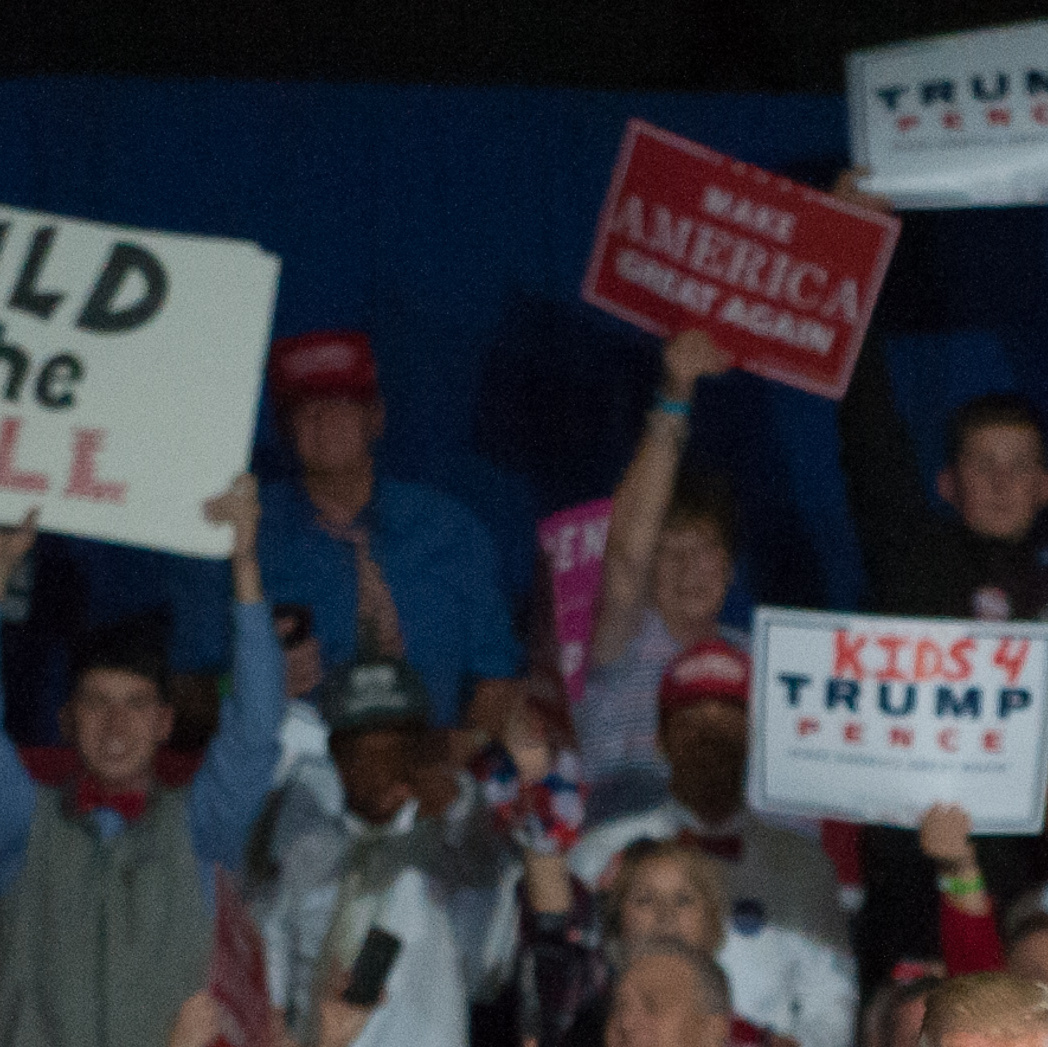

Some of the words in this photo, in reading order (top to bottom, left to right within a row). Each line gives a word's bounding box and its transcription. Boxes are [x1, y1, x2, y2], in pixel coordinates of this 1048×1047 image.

[609, 195, 858, 320] AMERICA
[832, 629, 976, 682] KIDS
[991, 636, 1031, 686] 4
[777, 672, 1033, 720] TRUMP
